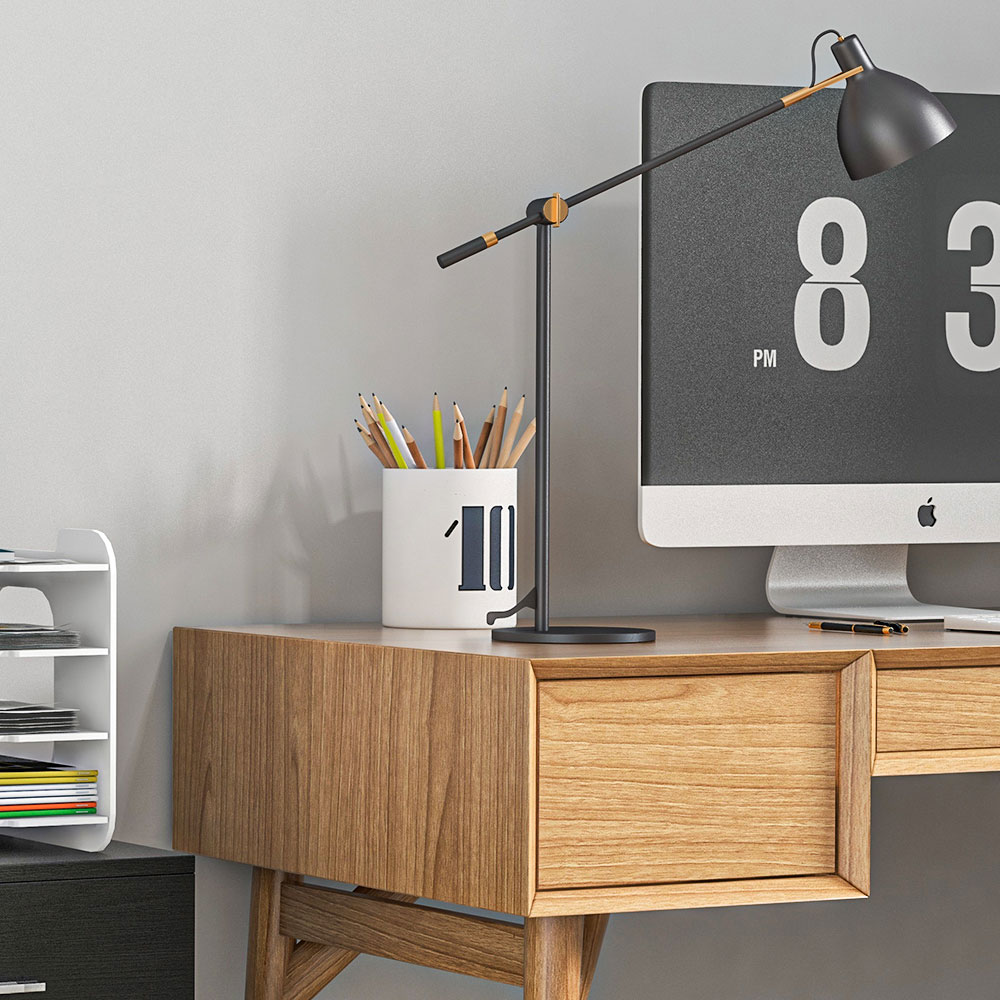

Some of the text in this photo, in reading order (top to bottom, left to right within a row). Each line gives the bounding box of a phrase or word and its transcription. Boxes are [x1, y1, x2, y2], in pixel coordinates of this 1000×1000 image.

[753, 197, 1000, 373] PM 8 3
